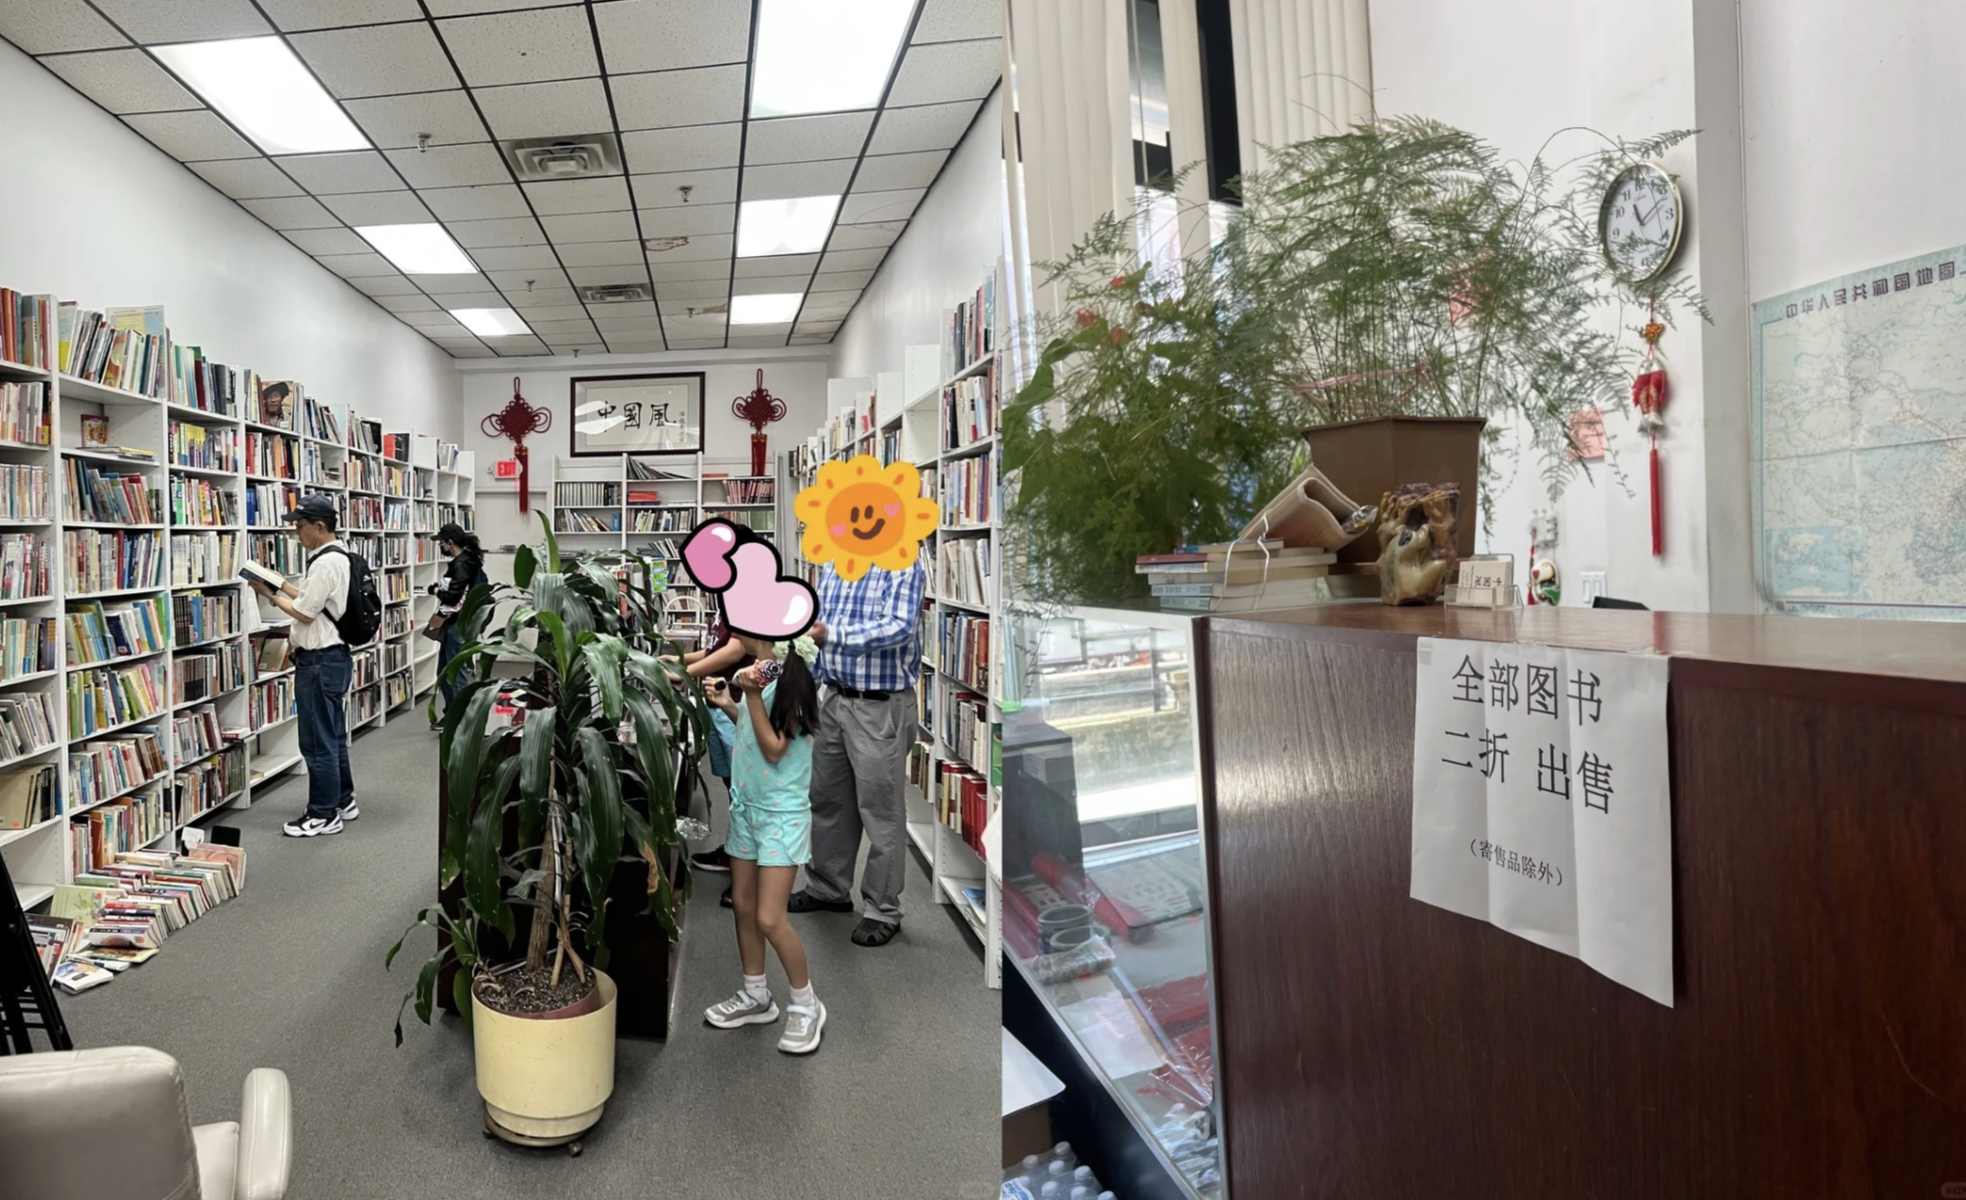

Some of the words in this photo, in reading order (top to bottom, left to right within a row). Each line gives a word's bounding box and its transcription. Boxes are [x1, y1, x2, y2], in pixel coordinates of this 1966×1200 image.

[1615, 206, 1625, 219] 10
[1665, 208, 1674, 220] 3
[1612, 228, 1620, 239] 9
[1785, 261, 1956, 319] 中华人民共和国地图
[497, 461, 516, 477] EXIT
[1451, 654, 1602, 726] 全部图书
[1441, 728, 1510, 783] 二折
[1537, 743, 1614, 815] 出售
[1470, 838, 1563, 887] （寄售品除外）
